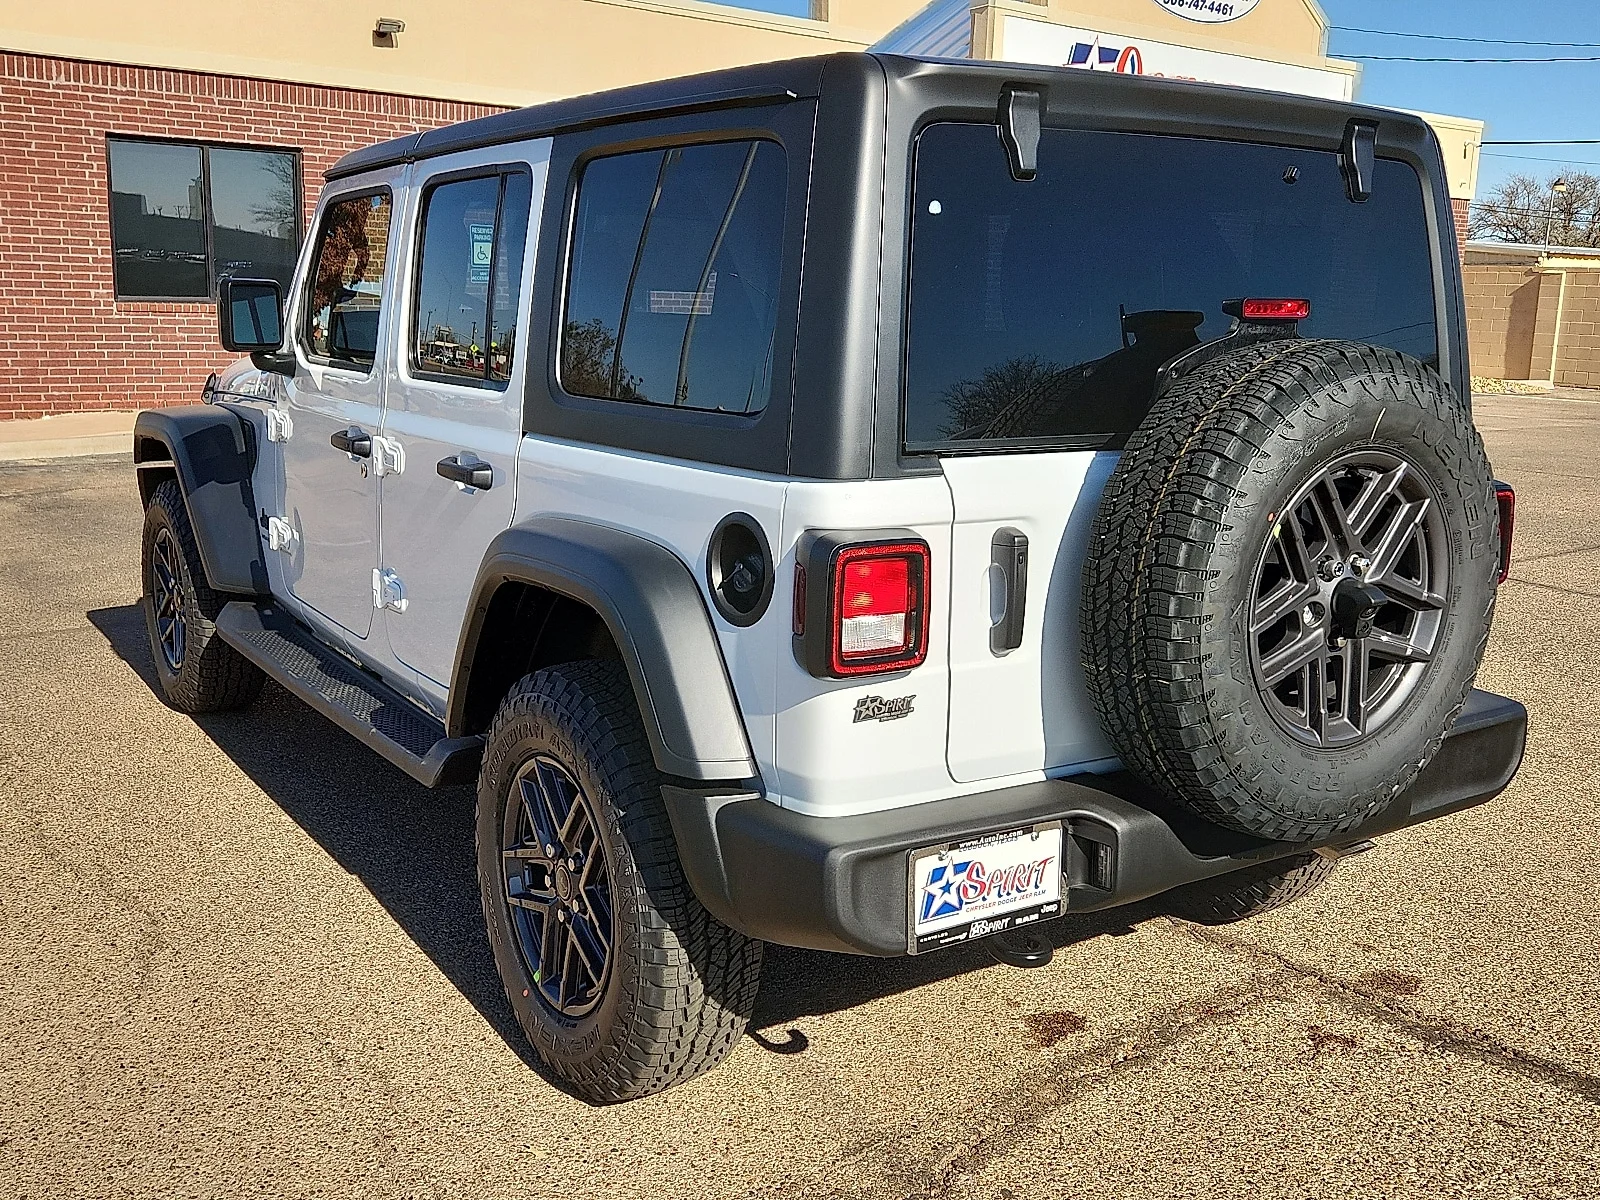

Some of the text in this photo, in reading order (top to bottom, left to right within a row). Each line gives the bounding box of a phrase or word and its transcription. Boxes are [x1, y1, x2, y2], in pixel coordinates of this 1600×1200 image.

[962, 856, 1055, 901] SPIRIT
[965, 901, 997, 913] CHRYSLER
[1040, 903, 1058, 914] Jeep
